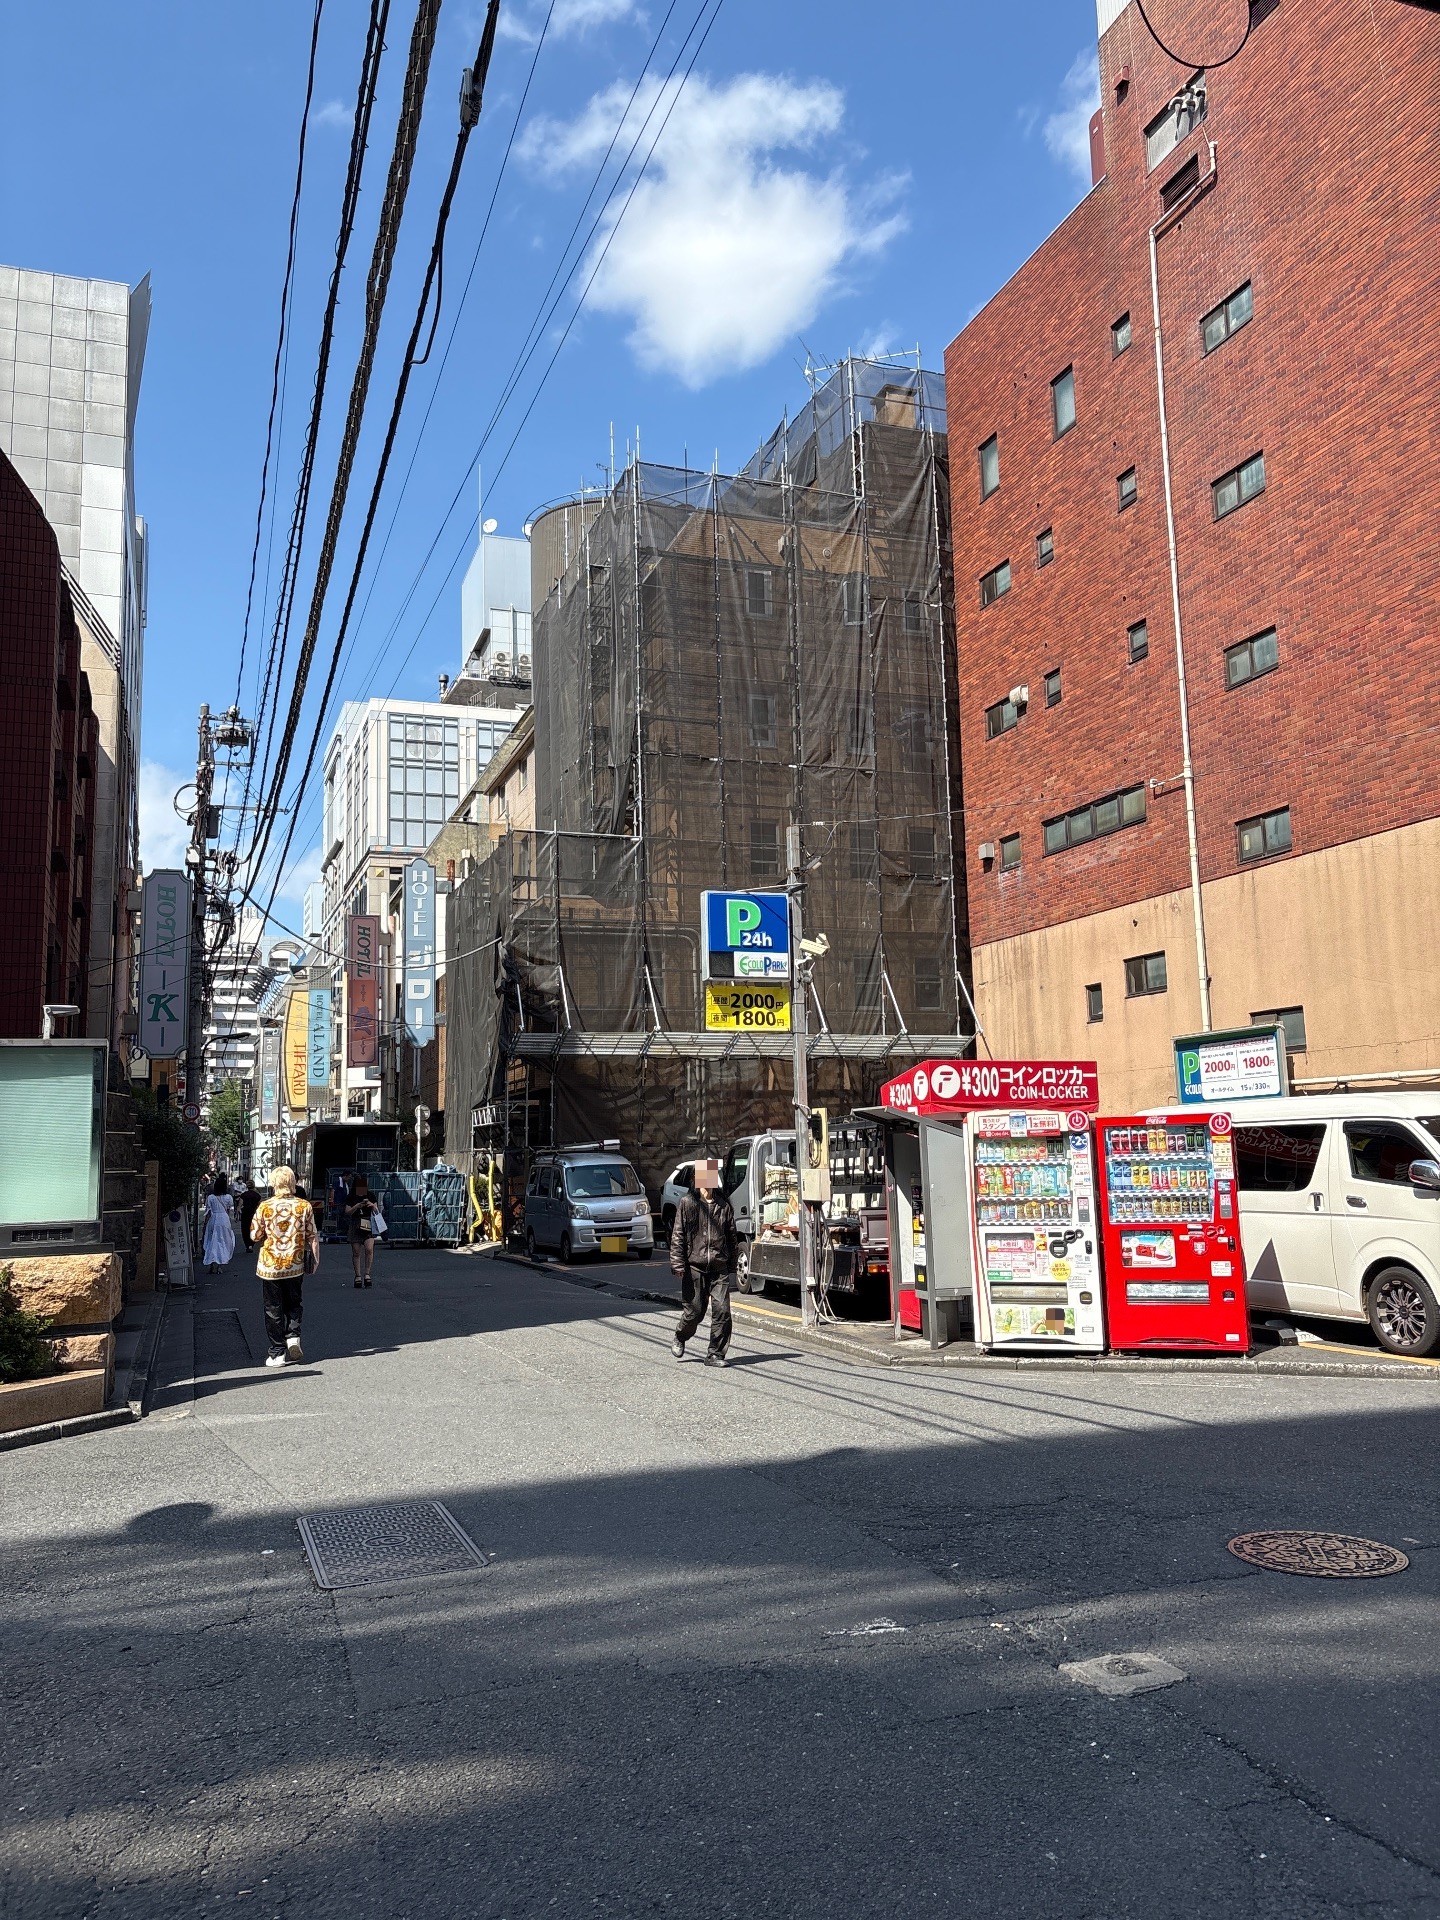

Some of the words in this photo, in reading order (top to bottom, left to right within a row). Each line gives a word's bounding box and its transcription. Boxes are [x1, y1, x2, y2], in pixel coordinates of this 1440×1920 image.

[411, 870, 428, 938] HOTEL
[156, 884, 177, 966] HOTEL
[726, 899, 762, 947] P
[357, 925, 371, 978] HOTEL
[742, 932, 773, 947] 24h
[316, 995, 324, 1020] HOTEL
[730, 993, 784, 1010] 2000円
[732, 1010, 785, 1026] 1800円
[1182, 1052, 1200, 1085] P
[1204, 1060, 1236, 1074] 2000円
[1242, 1055, 1276, 1070] 1800円
[961, 1066, 1000, 1097] ¥300
[1000, 1065, 1097, 1085] コインロッカー
[1009, 1085, 1089, 1100] COIN-LOCKER
[889, 1082, 912, 1107] ¥300
[982, 1122, 1007, 1130] スタンプ
